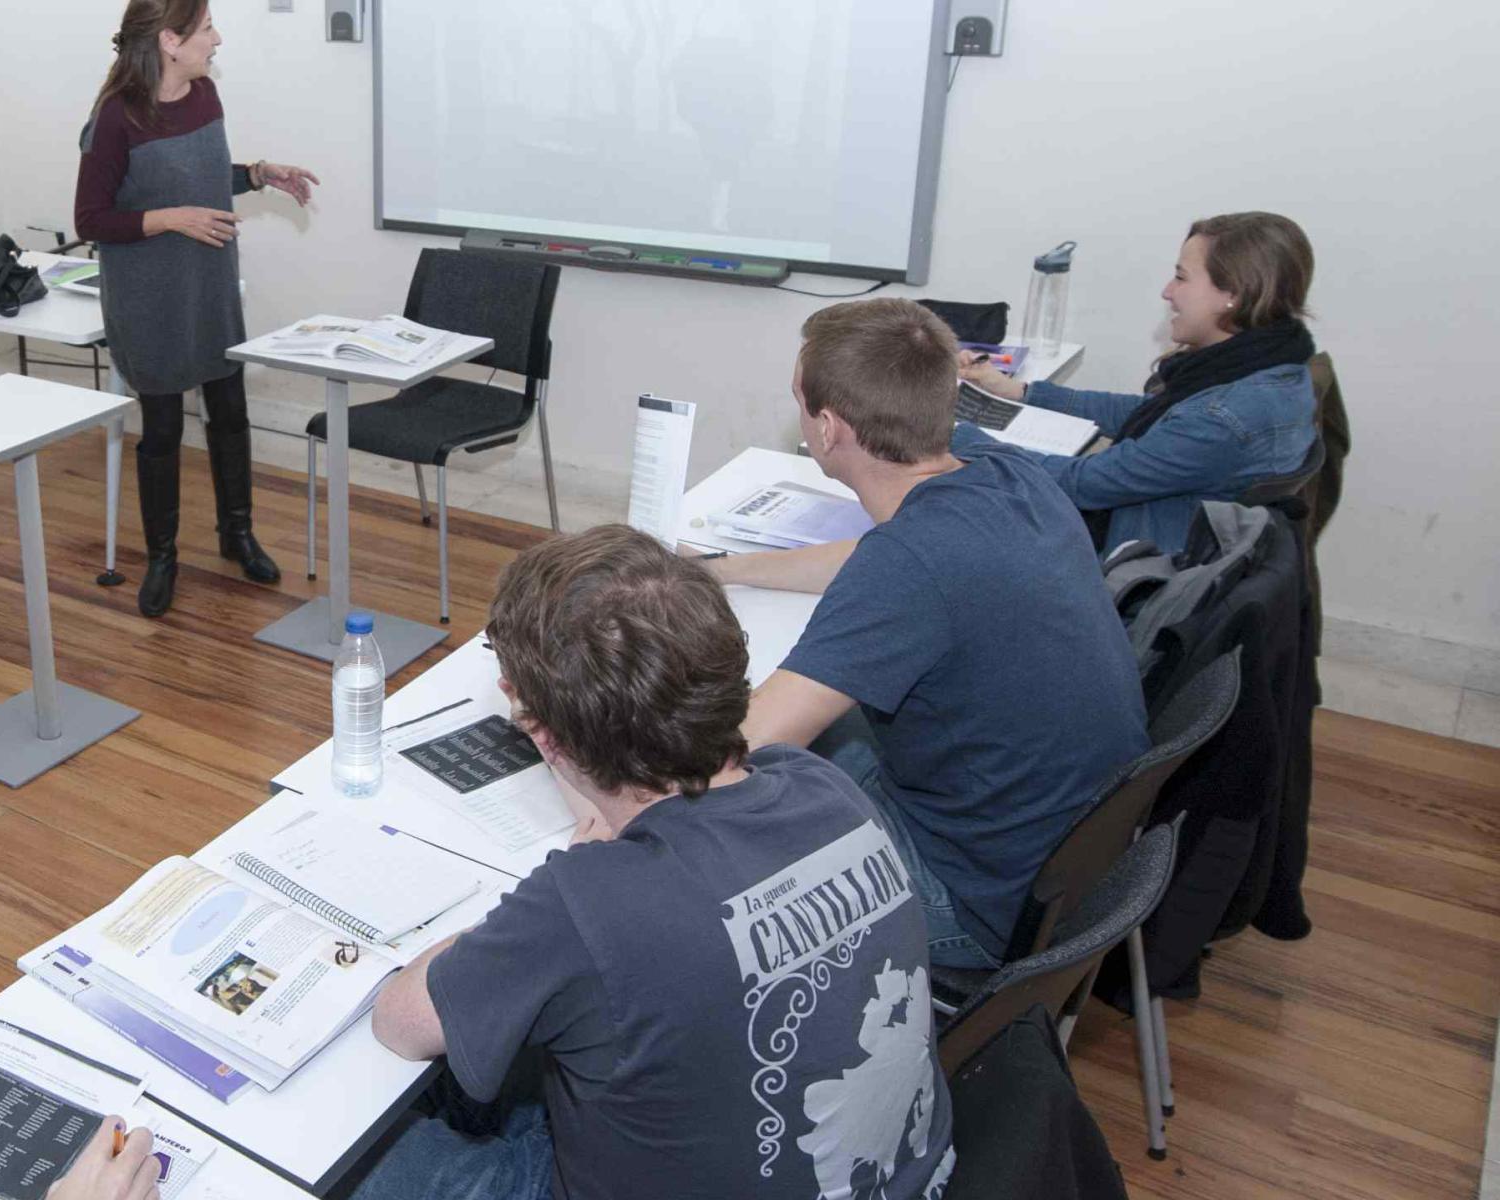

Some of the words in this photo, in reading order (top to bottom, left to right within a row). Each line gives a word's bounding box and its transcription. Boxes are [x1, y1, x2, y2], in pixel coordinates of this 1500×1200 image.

[743, 895, 763, 915] la
[762, 876, 797, 911] gueuze
[749, 845, 906, 974] CANTILLON
